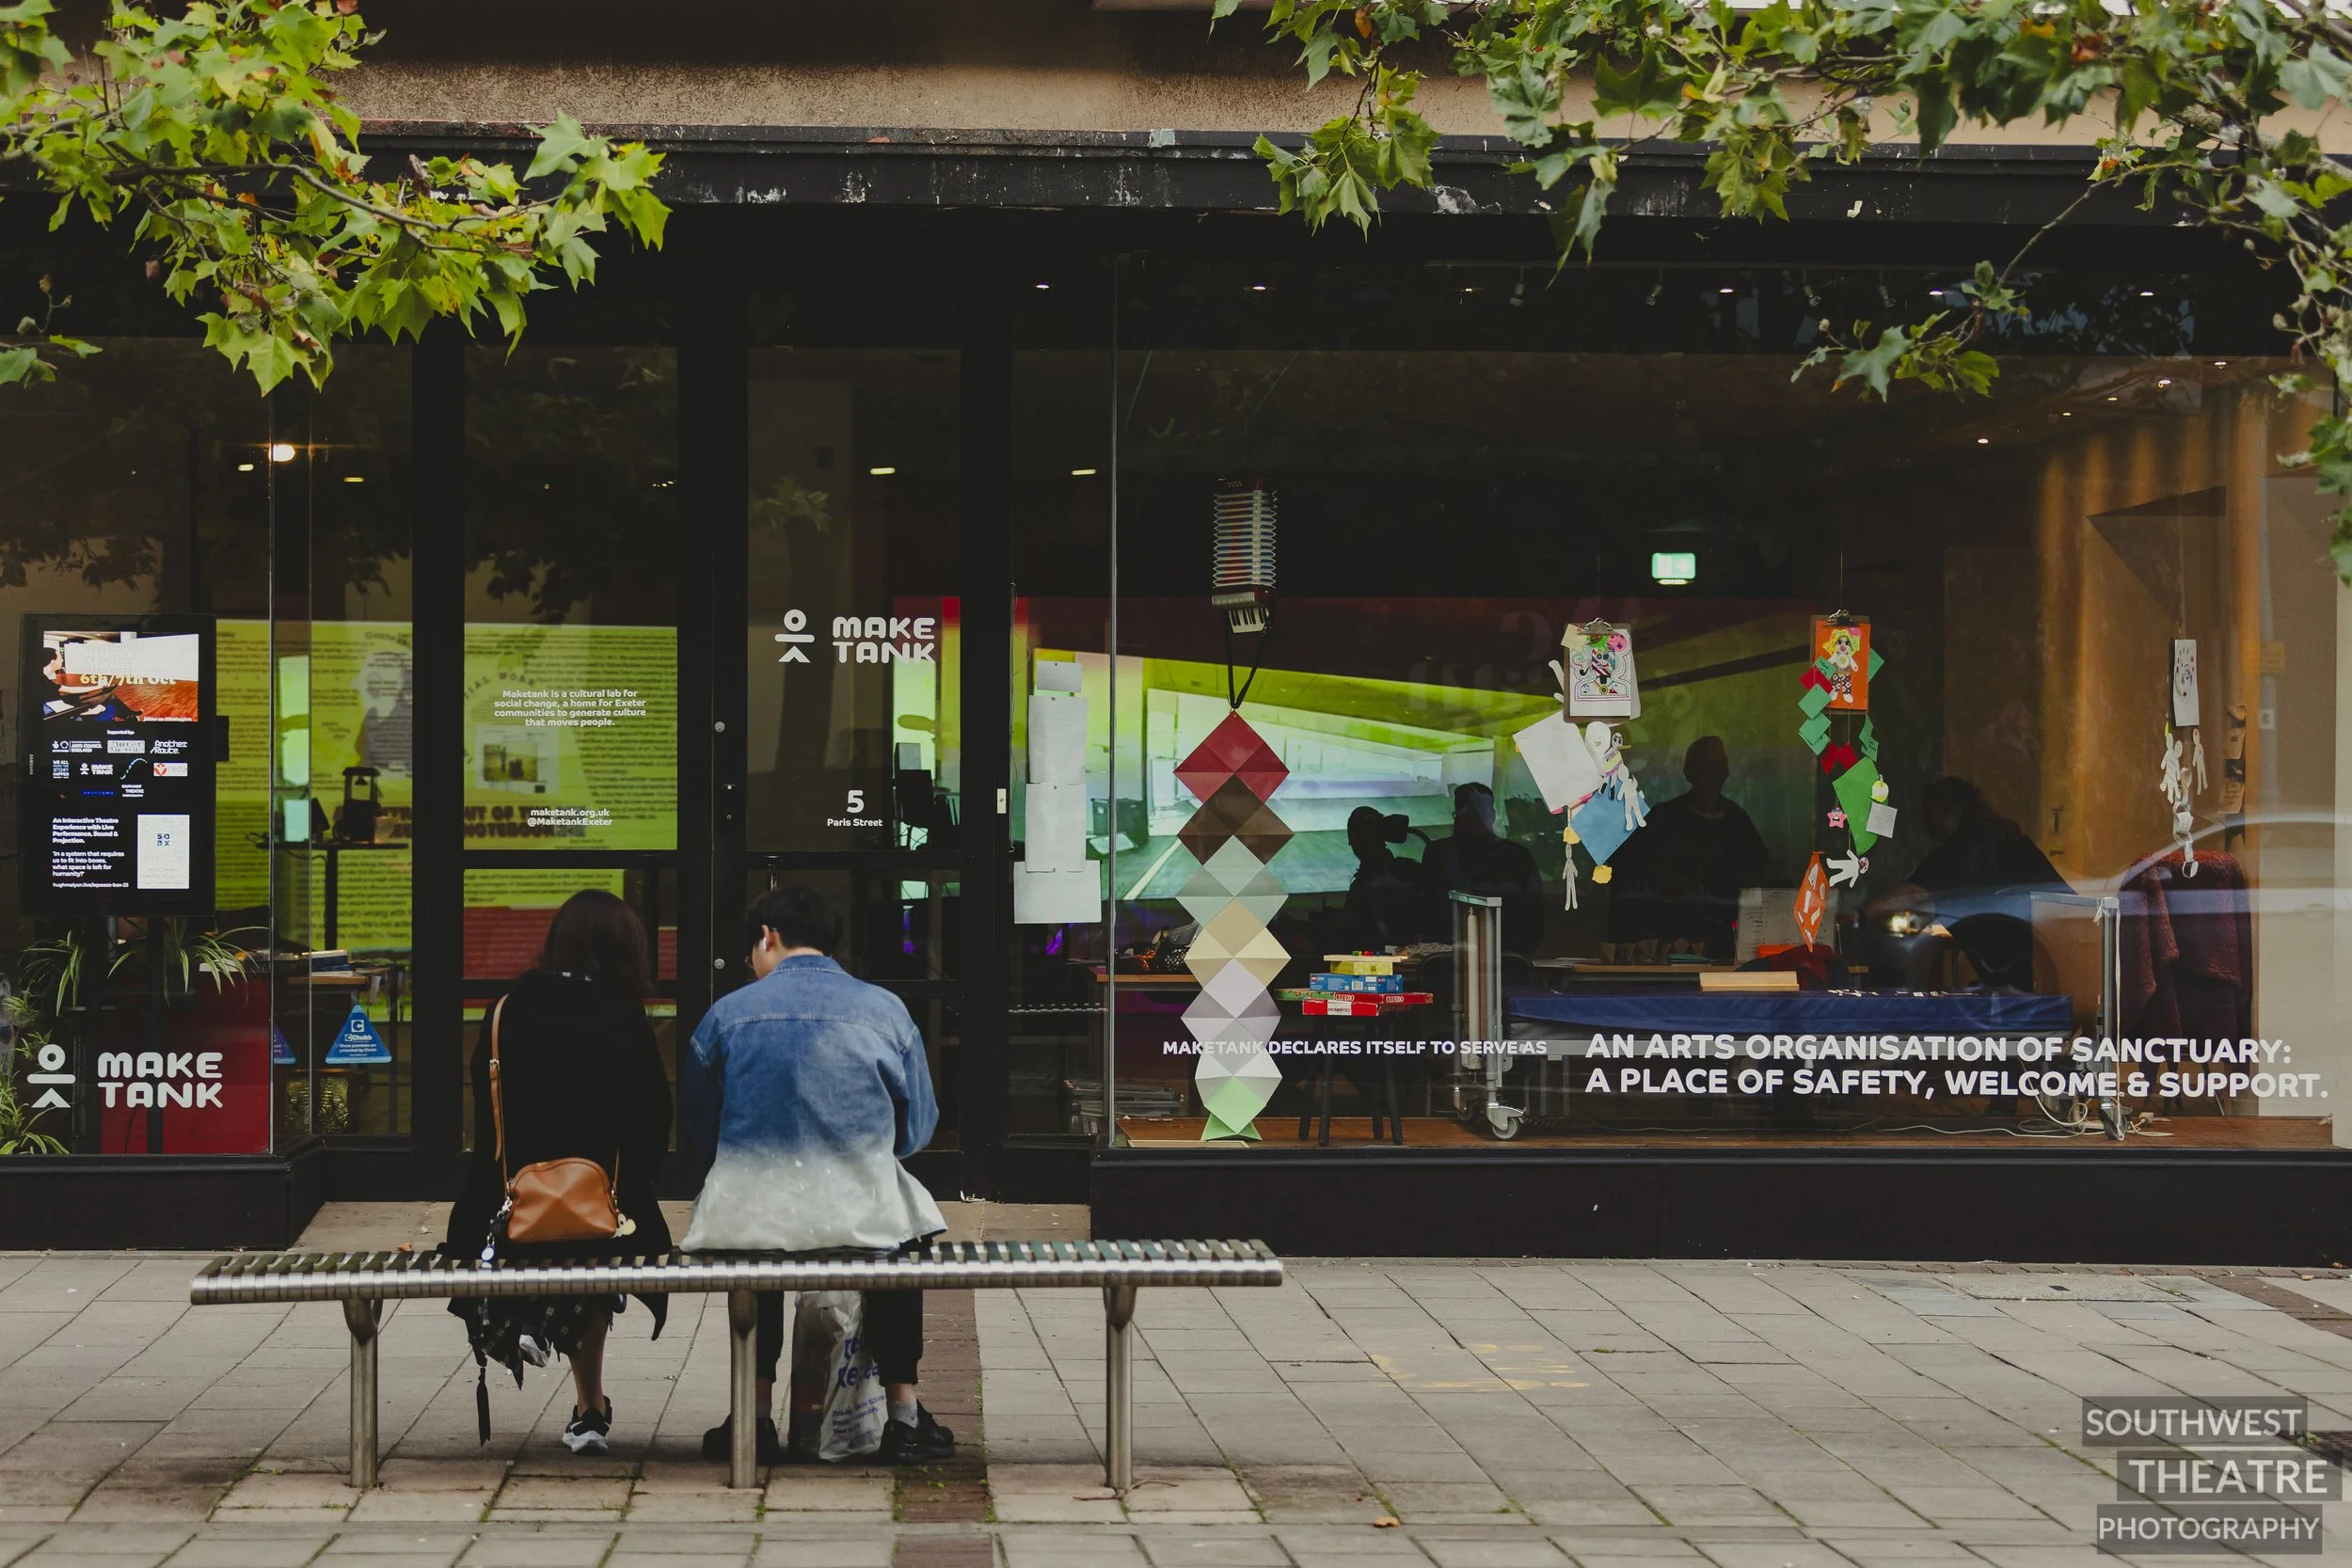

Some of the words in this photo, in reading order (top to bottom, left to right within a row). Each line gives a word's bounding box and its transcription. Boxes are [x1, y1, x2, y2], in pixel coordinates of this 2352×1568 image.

[832, 616, 936, 640] MAKE
[832, 641, 936, 664] TANK
[502, 689, 549, 698] Maketank
[551, 689, 560, 698] is
[569, 689, 605, 698] cultural
[607, 689, 621, 698] lab
[623, 689, 638, 698] for
[494, 699, 521, 707] social
[524, 699, 560, 709] change,
[570, 699, 596, 707] home
[598, 699, 613, 707] for
[494, 708, 555, 717] communities
[569, 709, 612, 718] generate
[613, 708, 646, 717] culture
[580, 718, 615, 727] people.
[846, 789, 866, 814] 5
[531, 808, 610, 818] maketank.org.uk
[527, 817, 612, 827] @MaketankExeter
[826, 818, 851, 827] Paris
[852, 818, 883, 827] Street
[1163, 1041, 1263, 1054] MAKETANK
[1269, 1040, 1361, 1054] DECLARES
[1366, 1040, 1426, 1054] ITSELF
[1430, 1040, 1455, 1054] TO
[1460, 1040, 1518, 1054] SERVE
[1519, 1040, 1548, 1054] AS
[1585, 1034, 1634, 1058] AN
[1645, 1034, 1736, 1059] ARTS
[1746, 1035, 2007, 1061] ORGANISATION
[2017, 1037, 2063, 1061] OF
[2073, 1037, 2292, 1064] SANCTUARY:
[97, 1052, 224, 1079] MAKE
[1585, 1069, 1611, 1093] A
[1621, 1069, 1728, 1094] PLACE
[1739, 1069, 1784, 1094] OF
[1793, 1069, 1934, 1100] SAFETY,
[1946, 1070, 2117, 1097] WELCOME
[2128, 1071, 2150, 1097] &
[2160, 1071, 2328, 1099] SUPPORT.
[97, 1082, 224, 1109] TANK
